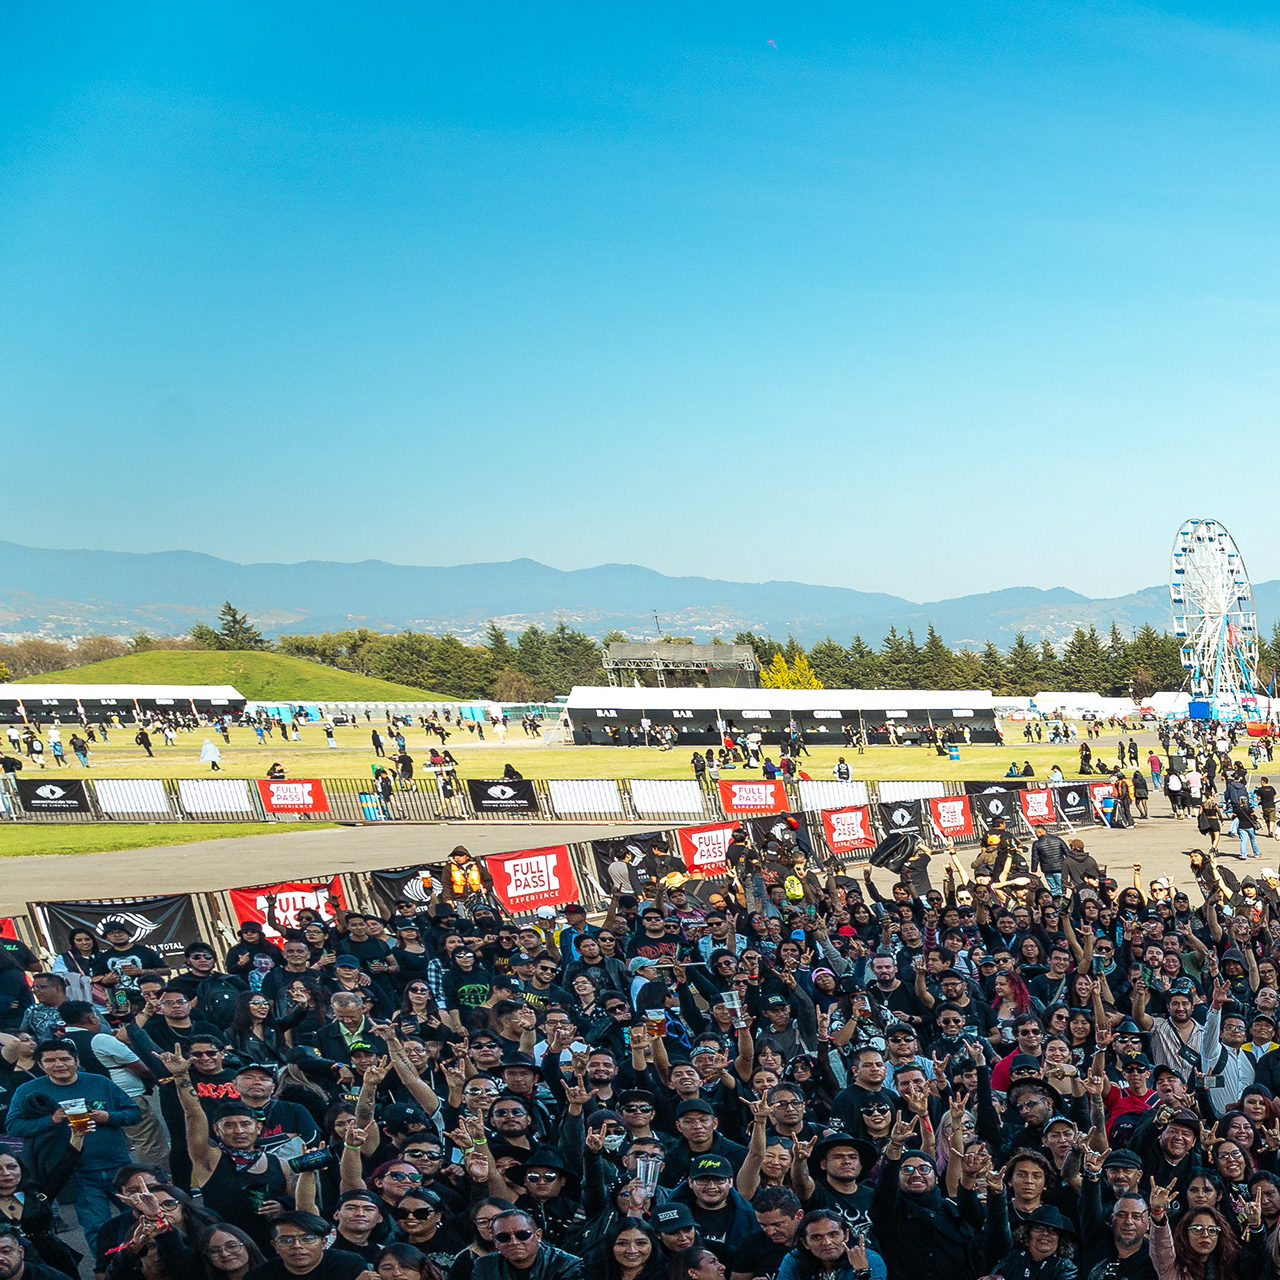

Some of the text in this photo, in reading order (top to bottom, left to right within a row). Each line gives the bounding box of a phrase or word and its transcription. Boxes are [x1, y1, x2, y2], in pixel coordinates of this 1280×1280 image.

[596, 710, 618, 718] BAR
[673, 710, 694, 718] BAR
[276, 786, 300, 794] FULL
[738, 787, 763, 795] FULL
[276, 794, 301, 802] PASS
[698, 834, 721, 849] FULL
[699, 847, 724, 860] PASS
[512, 861, 544, 877] FULL
[514, 874, 546, 891] PASS
[510, 890, 560, 905] EXPERIENCE
[158, 941, 184, 951] TOTAL
